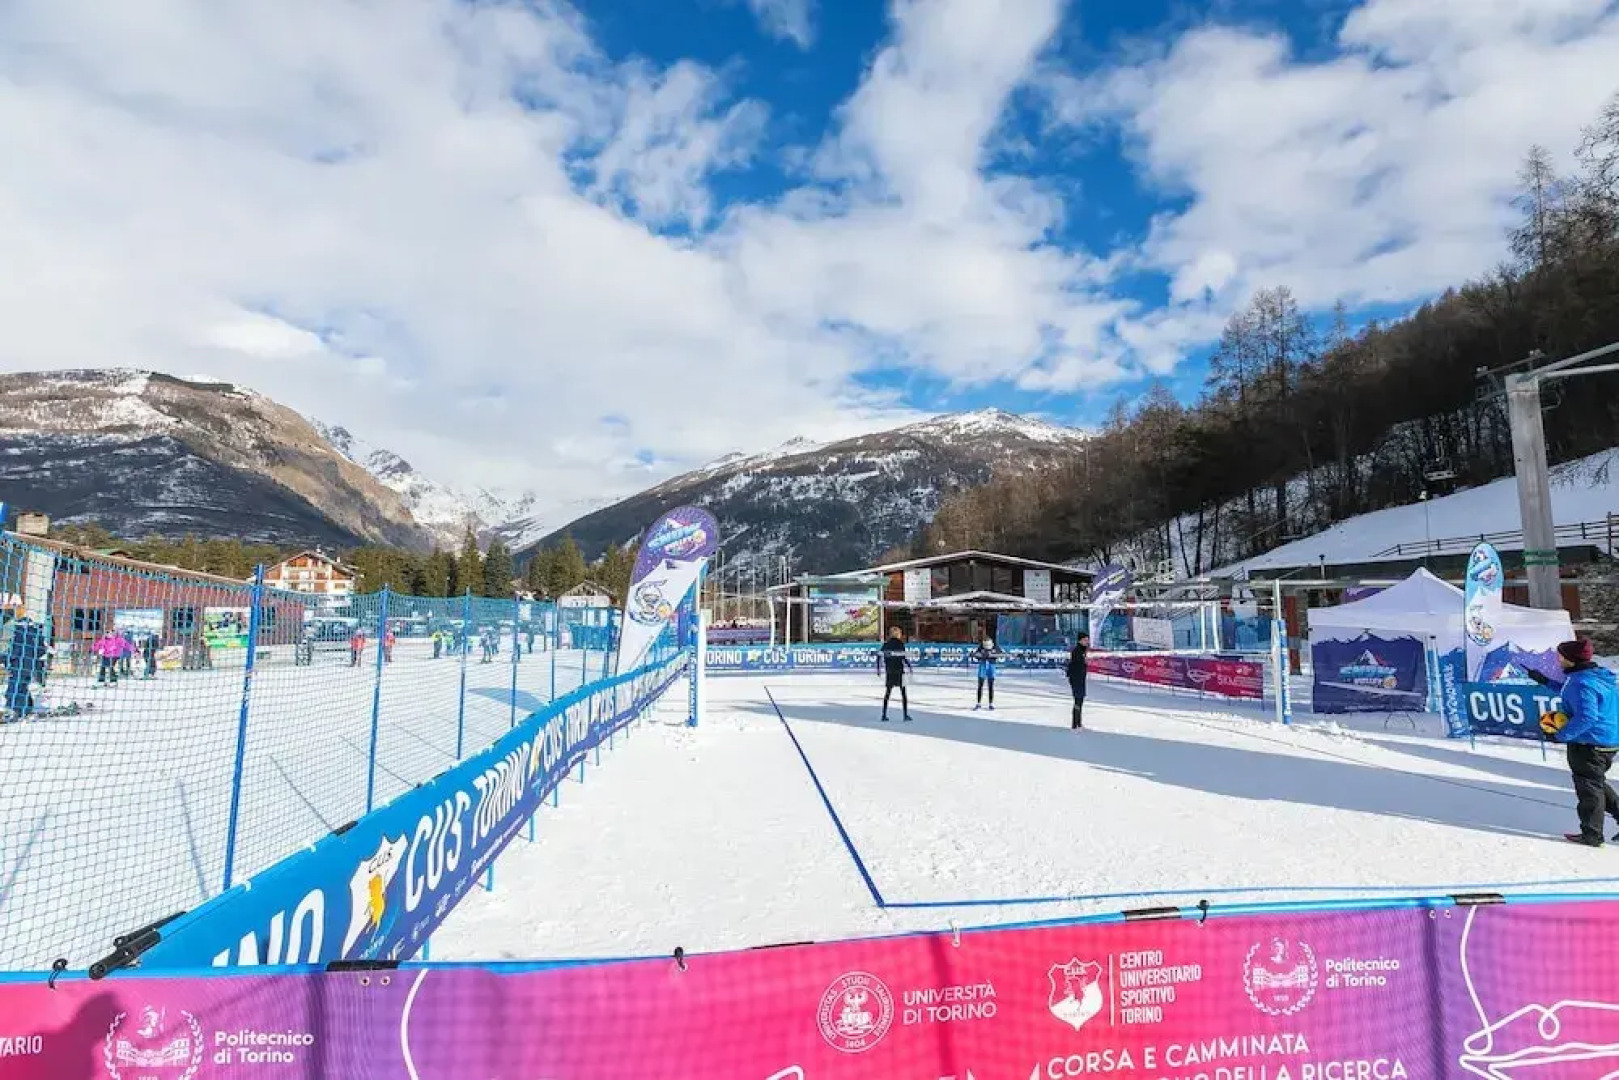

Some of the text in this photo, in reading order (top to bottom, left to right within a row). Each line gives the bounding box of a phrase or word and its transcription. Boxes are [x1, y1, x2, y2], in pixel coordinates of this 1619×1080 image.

[707, 651, 742, 665] ORINO
[763, 650, 788, 664] CUS
[1471, 691, 1524, 725] CUS
[405, 790, 472, 912] CUS
[472, 741, 531, 849] TORINO
[1119, 951, 1163, 969] CENTRO
[1325, 957, 1400, 973] Politecnico
[1119, 964, 1202, 987] UNIVERSITARIO
[1325, 972, 1386, 988] di Torino
[903, 979, 997, 1006] UNIVERSITÀ
[1120, 986, 1176, 1006] SPORTIVO
[903, 1001, 997, 1025] DI TORINO
[1120, 1006, 1163, 1025] TORINO
[214, 1030, 315, 1046] Politecnico
[214, 1047, 294, 1065] di Torino
[1047, 1032, 1310, 1079] CORSA E CAMMINATA
[1302, 1058, 1408, 1080] RICERCA
